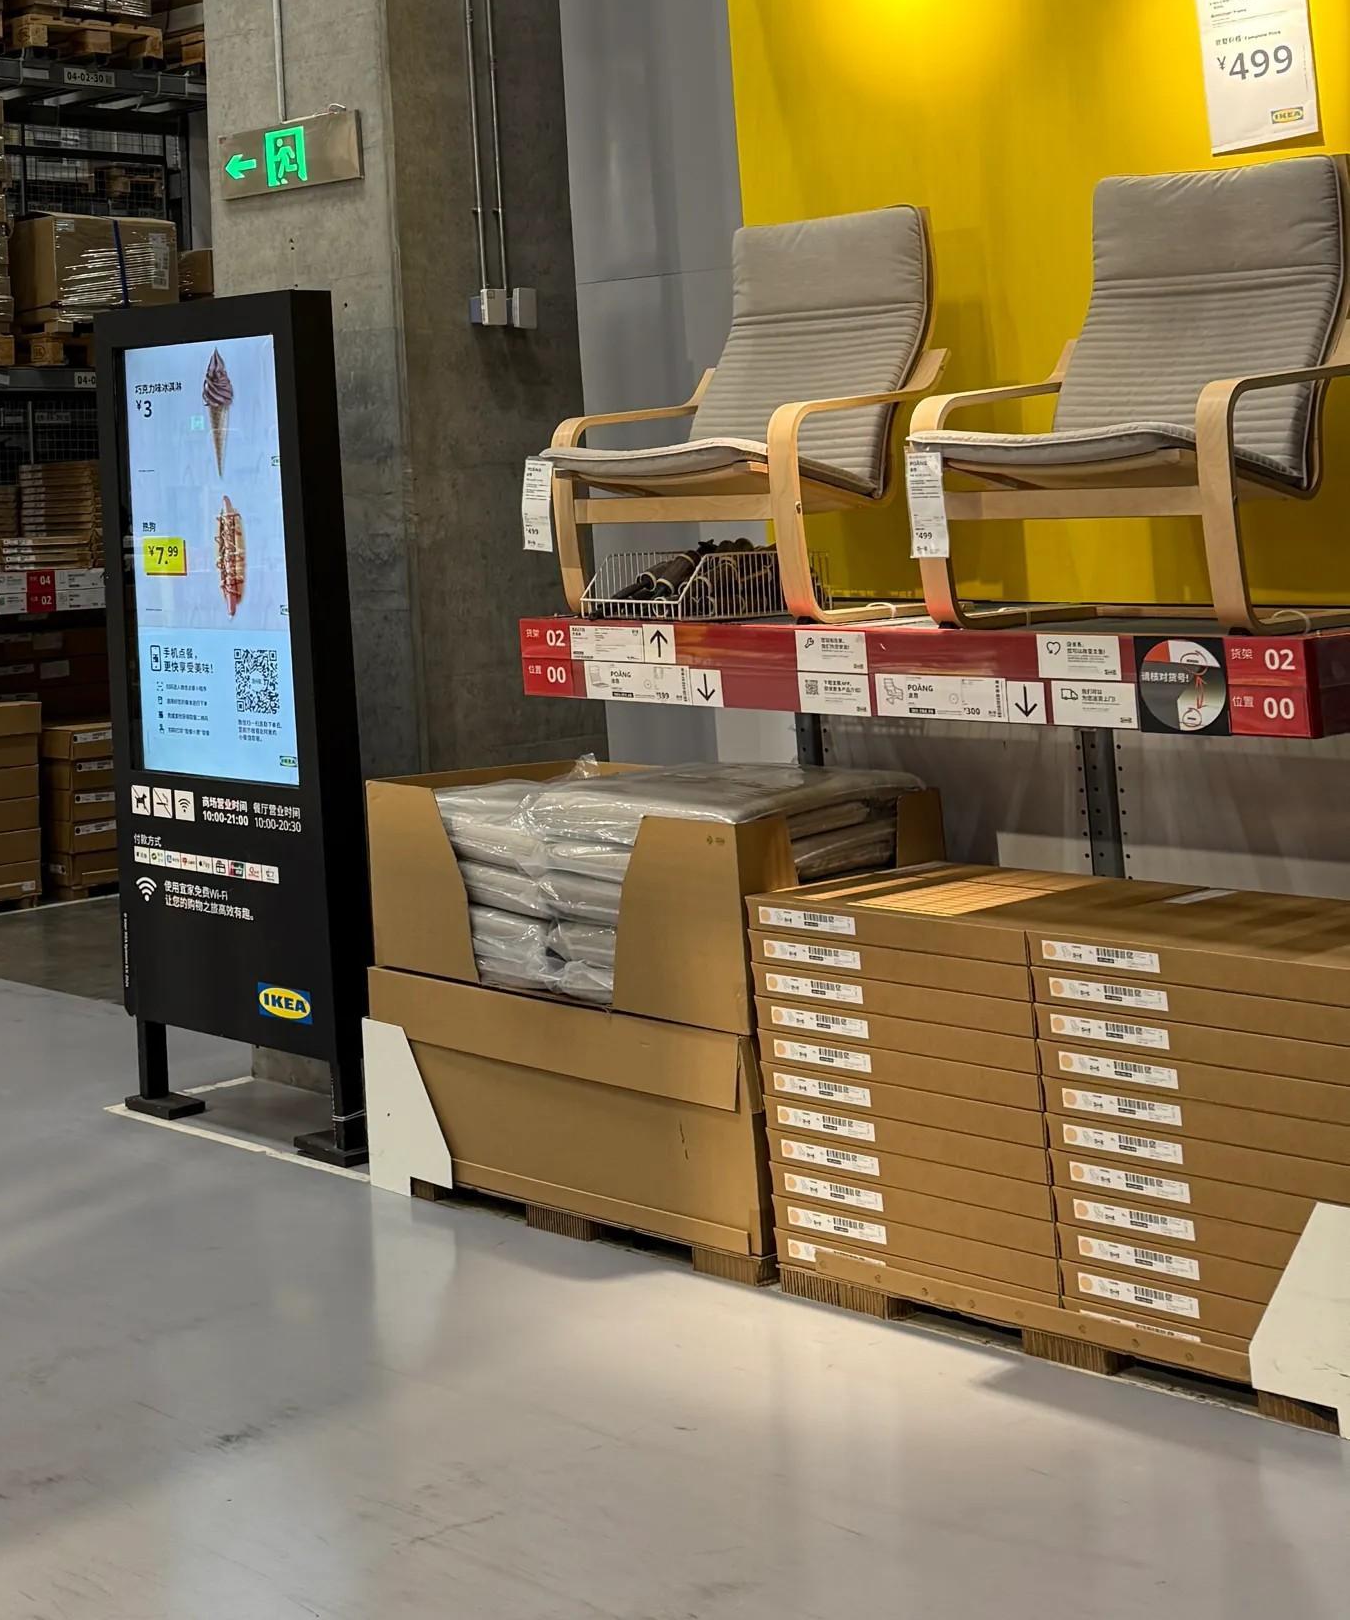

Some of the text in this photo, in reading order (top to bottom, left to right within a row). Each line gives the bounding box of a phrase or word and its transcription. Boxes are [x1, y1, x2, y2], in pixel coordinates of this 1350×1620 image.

[1217, 44, 1294, 81] ¥499
[66, 71, 104, 84] 04-02-30
[135, 381, 182, 395] 巧克力味冰淇淋
[135, 399, 153, 418] ¥3
[40, 575, 51, 586] 04
[41, 595, 53, 605] 02
[546, 630, 566, 647] 02
[1264, 648, 1296, 671] 02
[546, 666, 566, 683] 00
[1263, 697, 1295, 720] 00
[202, 795, 248, 812] 商场营业时间
[253, 802, 301, 819] 餐厅营业时间
[202, 810, 249, 826] 10:00-21:00
[254, 817, 302, 833] 10:00-20:30
[133, 833, 162, 847] 付款方式
[164, 880, 228, 901] 使用宜家免费Wi-Fi
[263, 992, 307, 1014] IKEA
